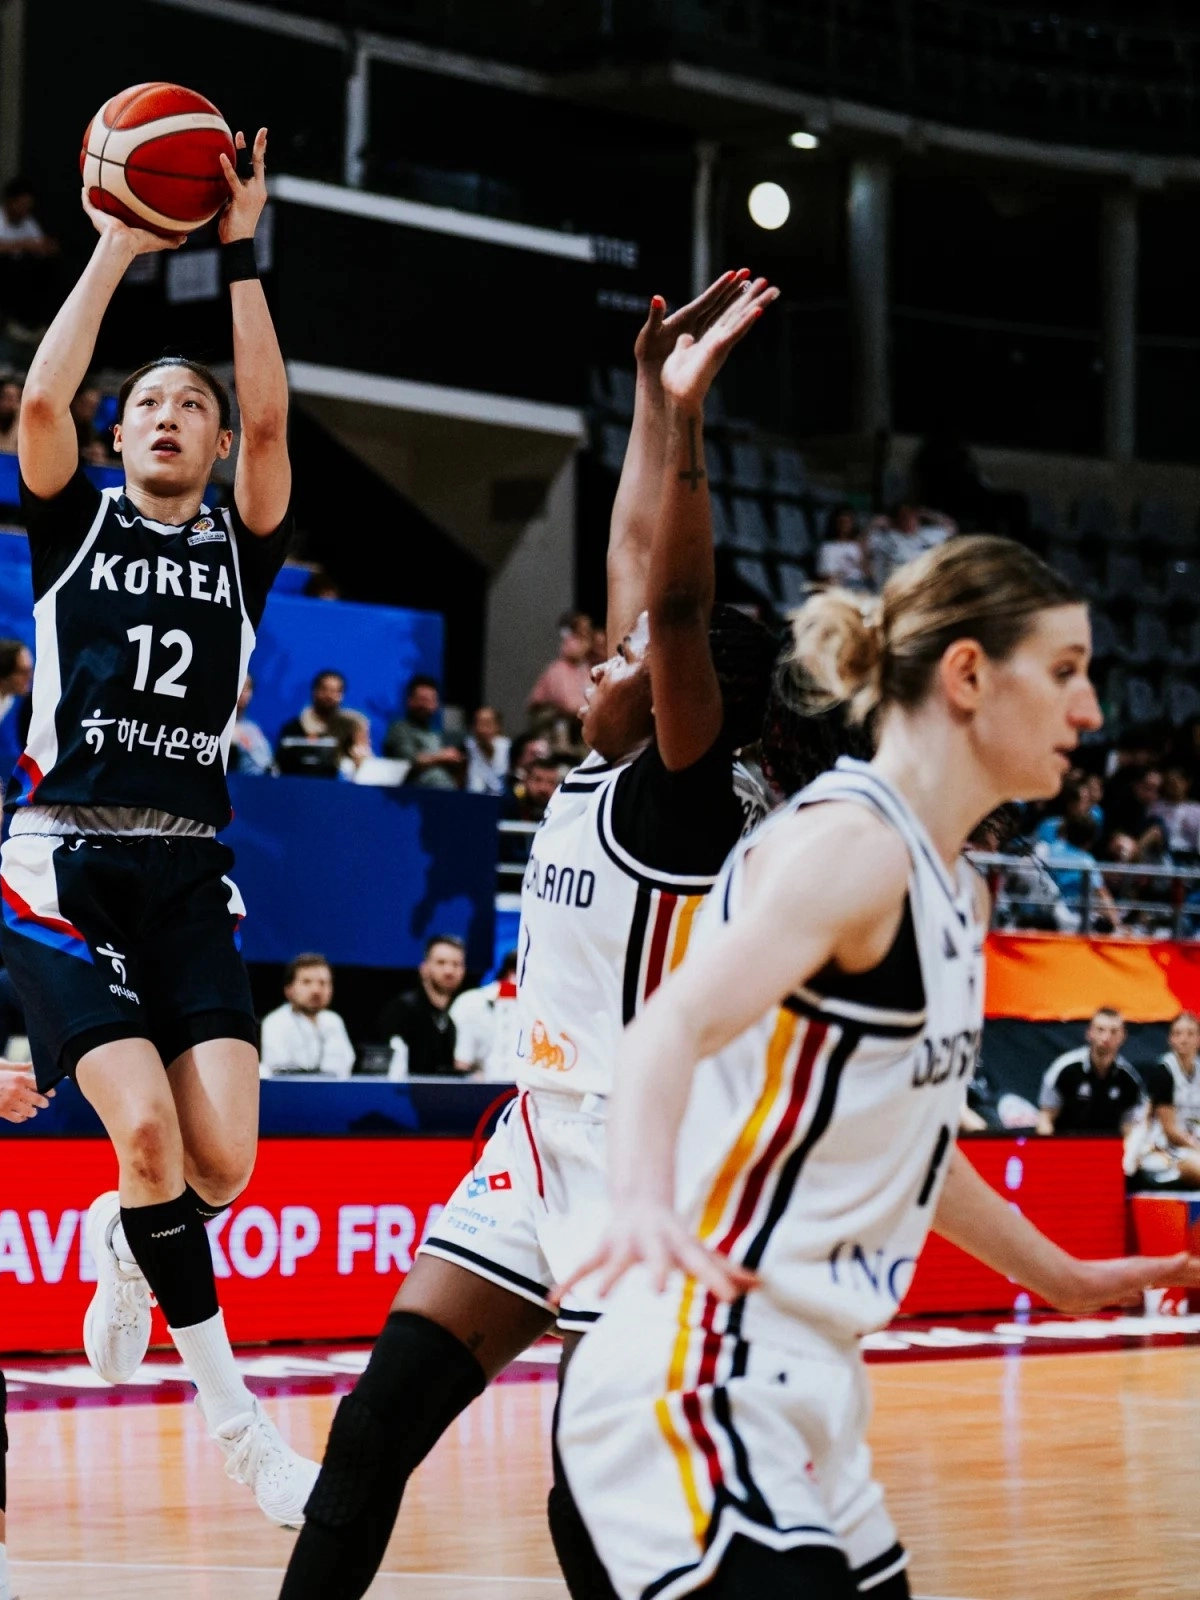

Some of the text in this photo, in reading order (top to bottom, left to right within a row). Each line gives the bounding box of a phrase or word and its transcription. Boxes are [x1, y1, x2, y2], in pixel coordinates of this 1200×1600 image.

[90, 552, 232, 608] KOREA
[127, 624, 193, 698] 12
[117, 717, 220, 766] 하나은행
